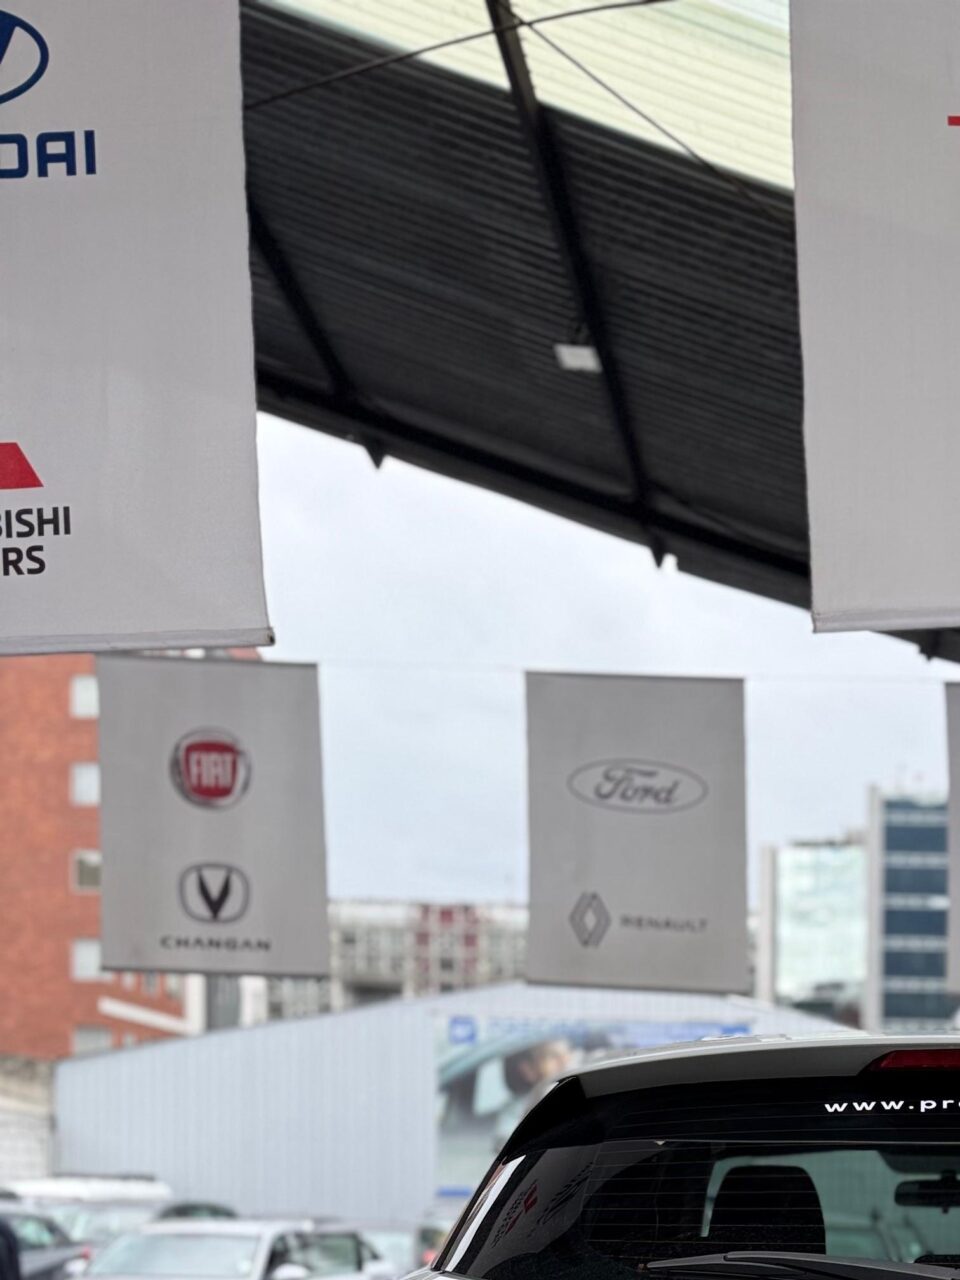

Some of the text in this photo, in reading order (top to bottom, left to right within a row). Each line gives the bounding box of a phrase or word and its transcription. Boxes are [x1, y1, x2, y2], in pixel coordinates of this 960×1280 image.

[0, 506, 71, 538] ISHI
[189, 752, 234, 788] FIAT
[594, 767, 681, 803] Ford
[619, 914, 708, 933] RENAULT
[159, 934, 272, 951] CHANGAN
